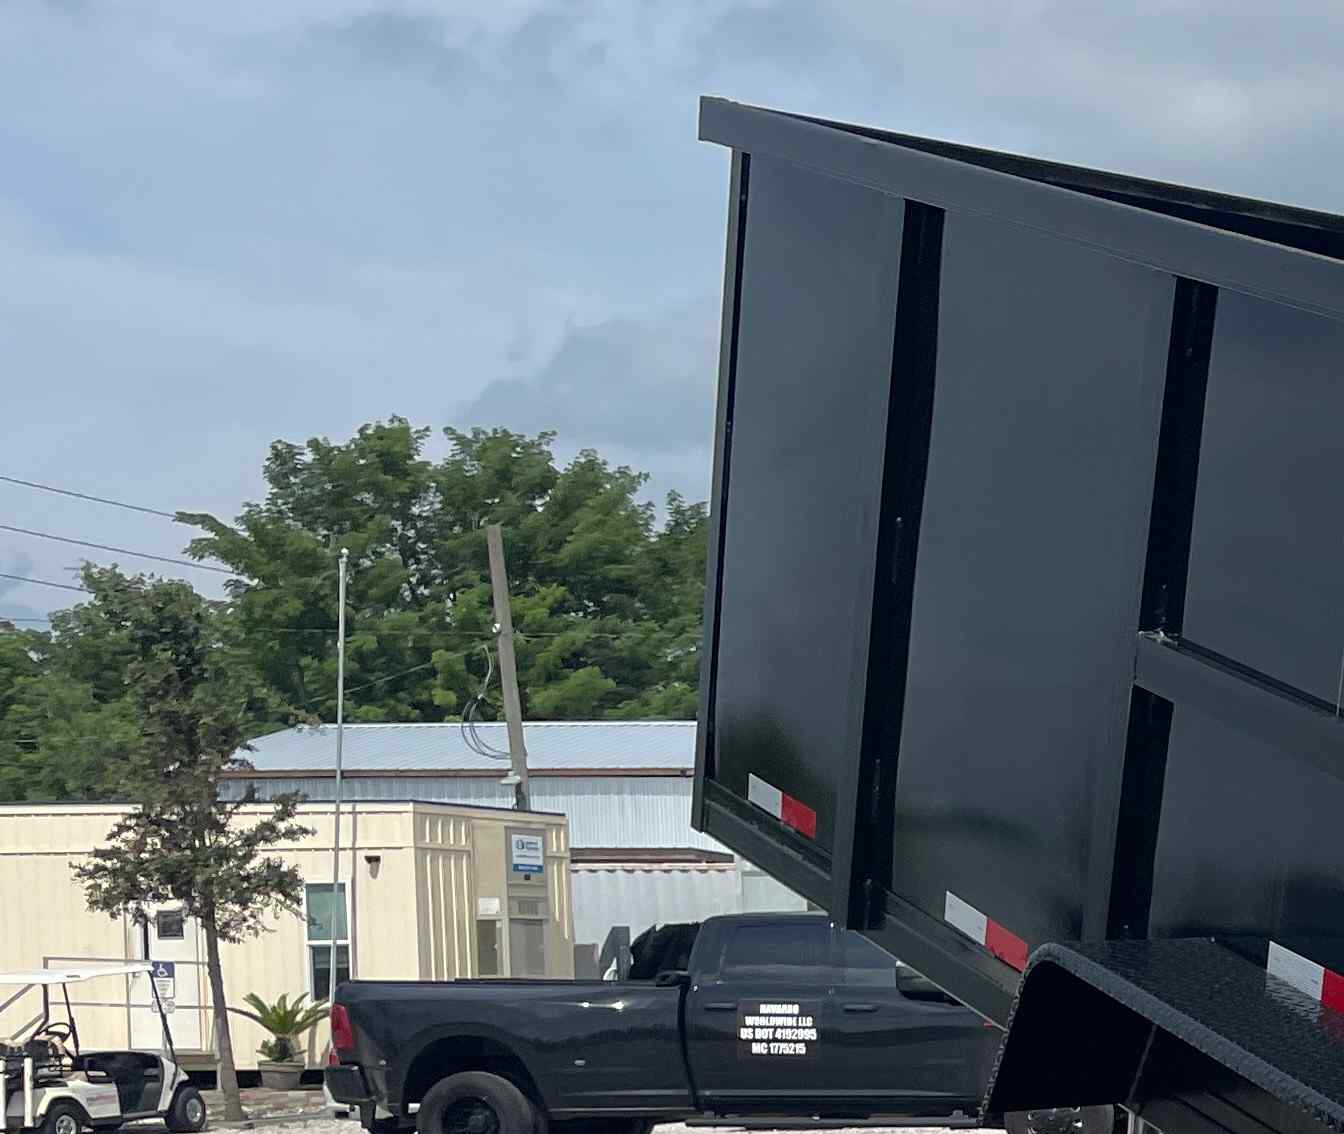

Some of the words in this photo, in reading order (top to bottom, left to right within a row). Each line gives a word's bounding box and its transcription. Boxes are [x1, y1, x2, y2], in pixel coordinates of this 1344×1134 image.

[745, 1016, 797, 1026] WORLDWIDE
[798, 1016, 813, 1027] LLC
[740, 1028, 753, 1039] US
[755, 1028, 774, 1039] DOT
[752, 1043, 768, 1054] MC
